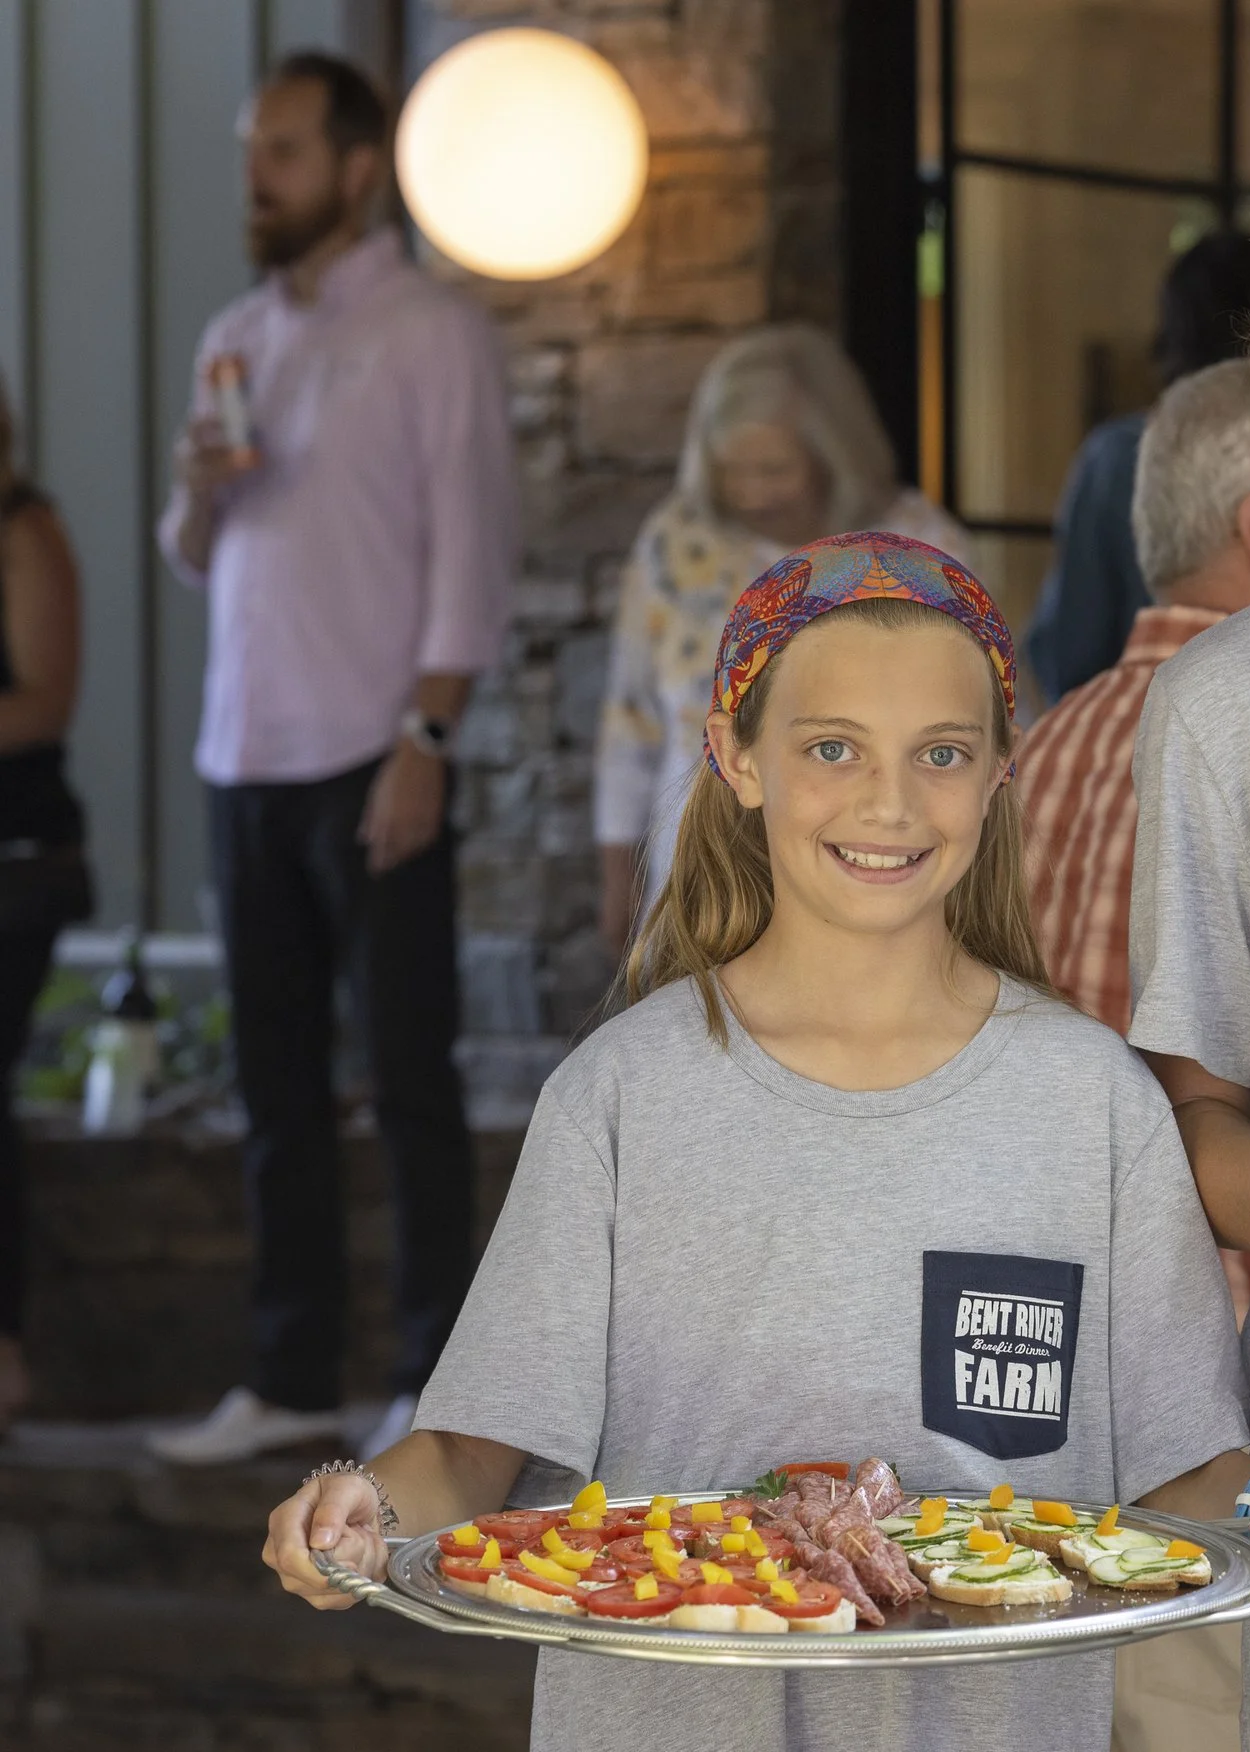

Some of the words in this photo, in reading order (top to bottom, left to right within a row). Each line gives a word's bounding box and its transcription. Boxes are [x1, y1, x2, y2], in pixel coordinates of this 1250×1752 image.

[955, 1297, 1013, 1338] BENT
[1014, 1303, 1064, 1349] RIVER
[971, 1338, 1013, 1355] Benefit
[1014, 1343, 1050, 1357] Dinner
[955, 1348, 1062, 1414] FARM
